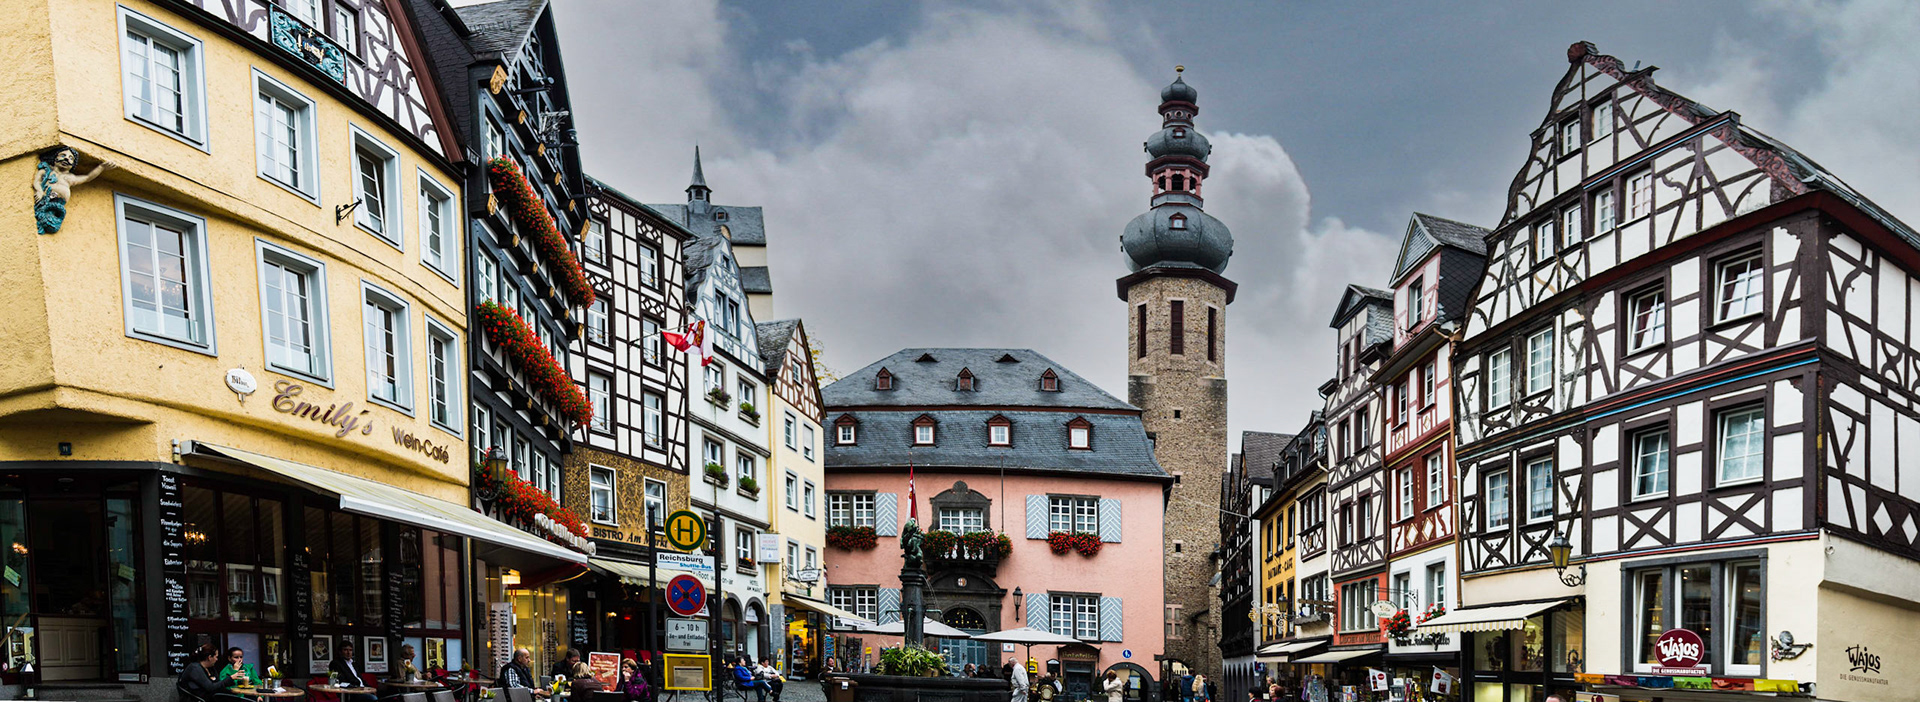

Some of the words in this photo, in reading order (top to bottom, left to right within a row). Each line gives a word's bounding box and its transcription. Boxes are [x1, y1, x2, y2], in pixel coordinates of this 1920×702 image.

[392, 425, 449, 464] Wein-Café
[593, 527, 623, 541] BISTRO
[627, 532, 641, 543] Am
[677, 519, 693, 542] H
[659, 554, 703, 563] Reichsburg
[675, 623, 679, 631] 6
[1848, 675, 1889, 685] GENUSSMANUFAKTUR
